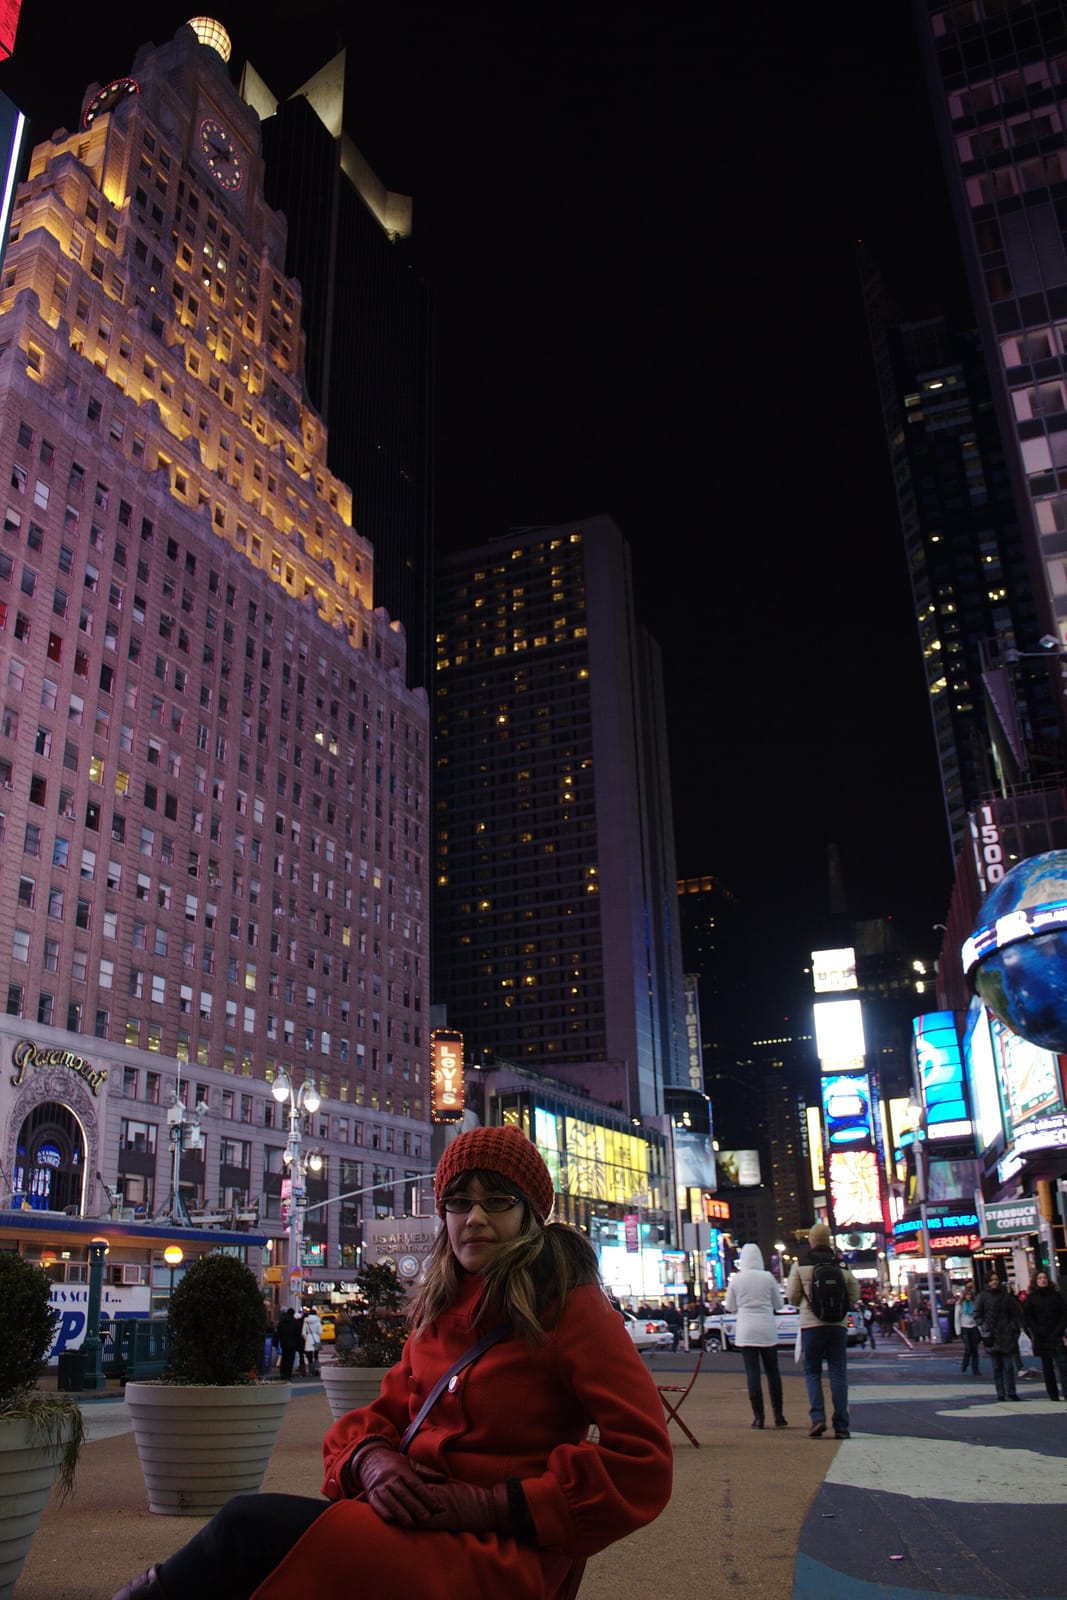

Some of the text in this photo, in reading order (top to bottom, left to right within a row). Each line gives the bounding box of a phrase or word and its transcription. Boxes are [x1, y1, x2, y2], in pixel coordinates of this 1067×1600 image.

[981, 806, 1005, 884] 1500
[11, 1040, 108, 1097] Paramount
[797, 1102, 808, 1157] NOVOTEL
[996, 1216, 1034, 1229] COFFEE
